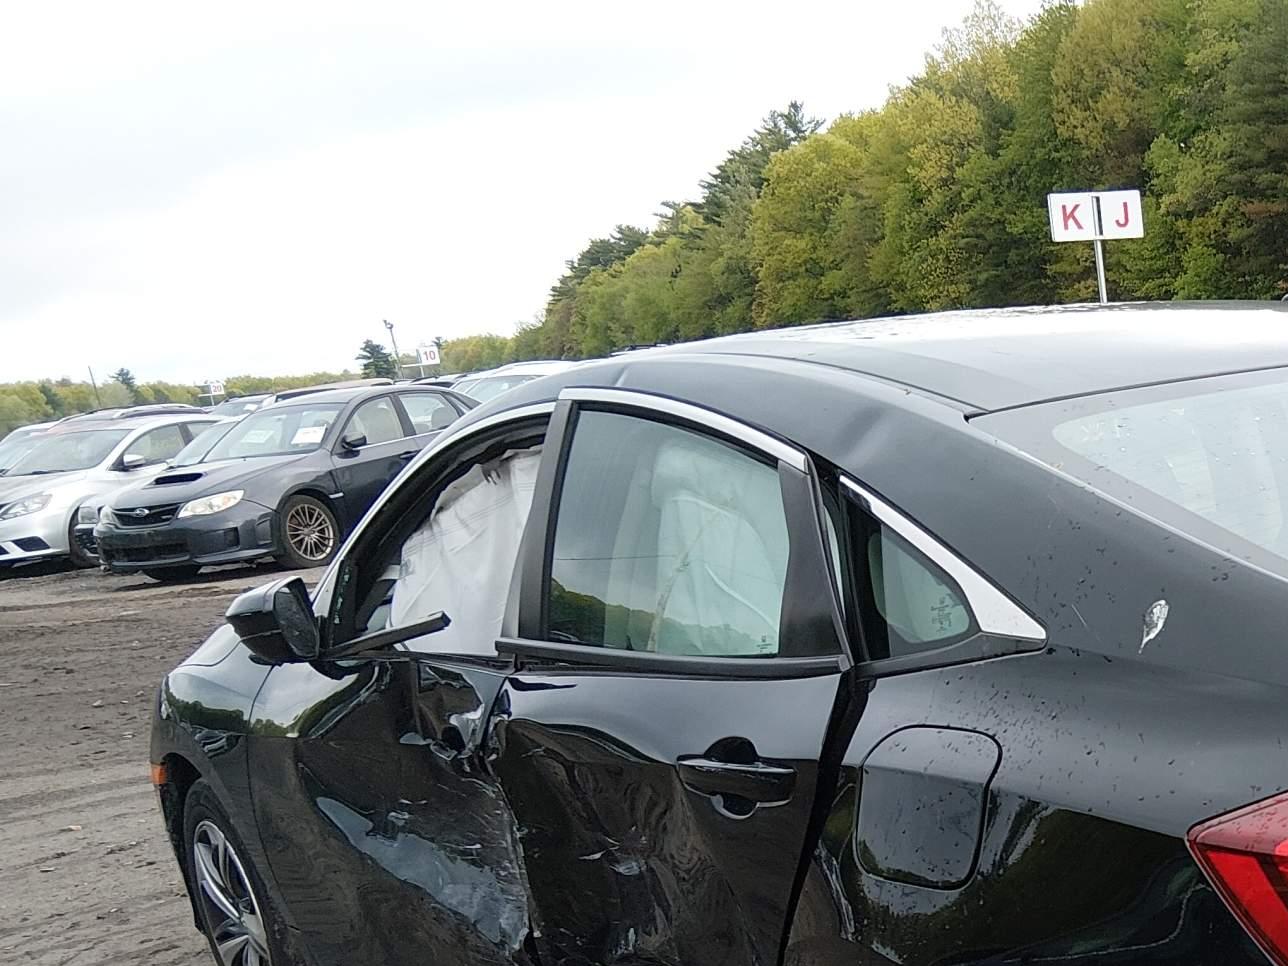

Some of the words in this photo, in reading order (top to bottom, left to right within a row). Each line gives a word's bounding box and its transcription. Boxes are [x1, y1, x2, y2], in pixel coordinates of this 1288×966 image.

[1061, 203, 1084, 231] K
[1114, 201, 1130, 228] J
[423, 350, 436, 361] 10
